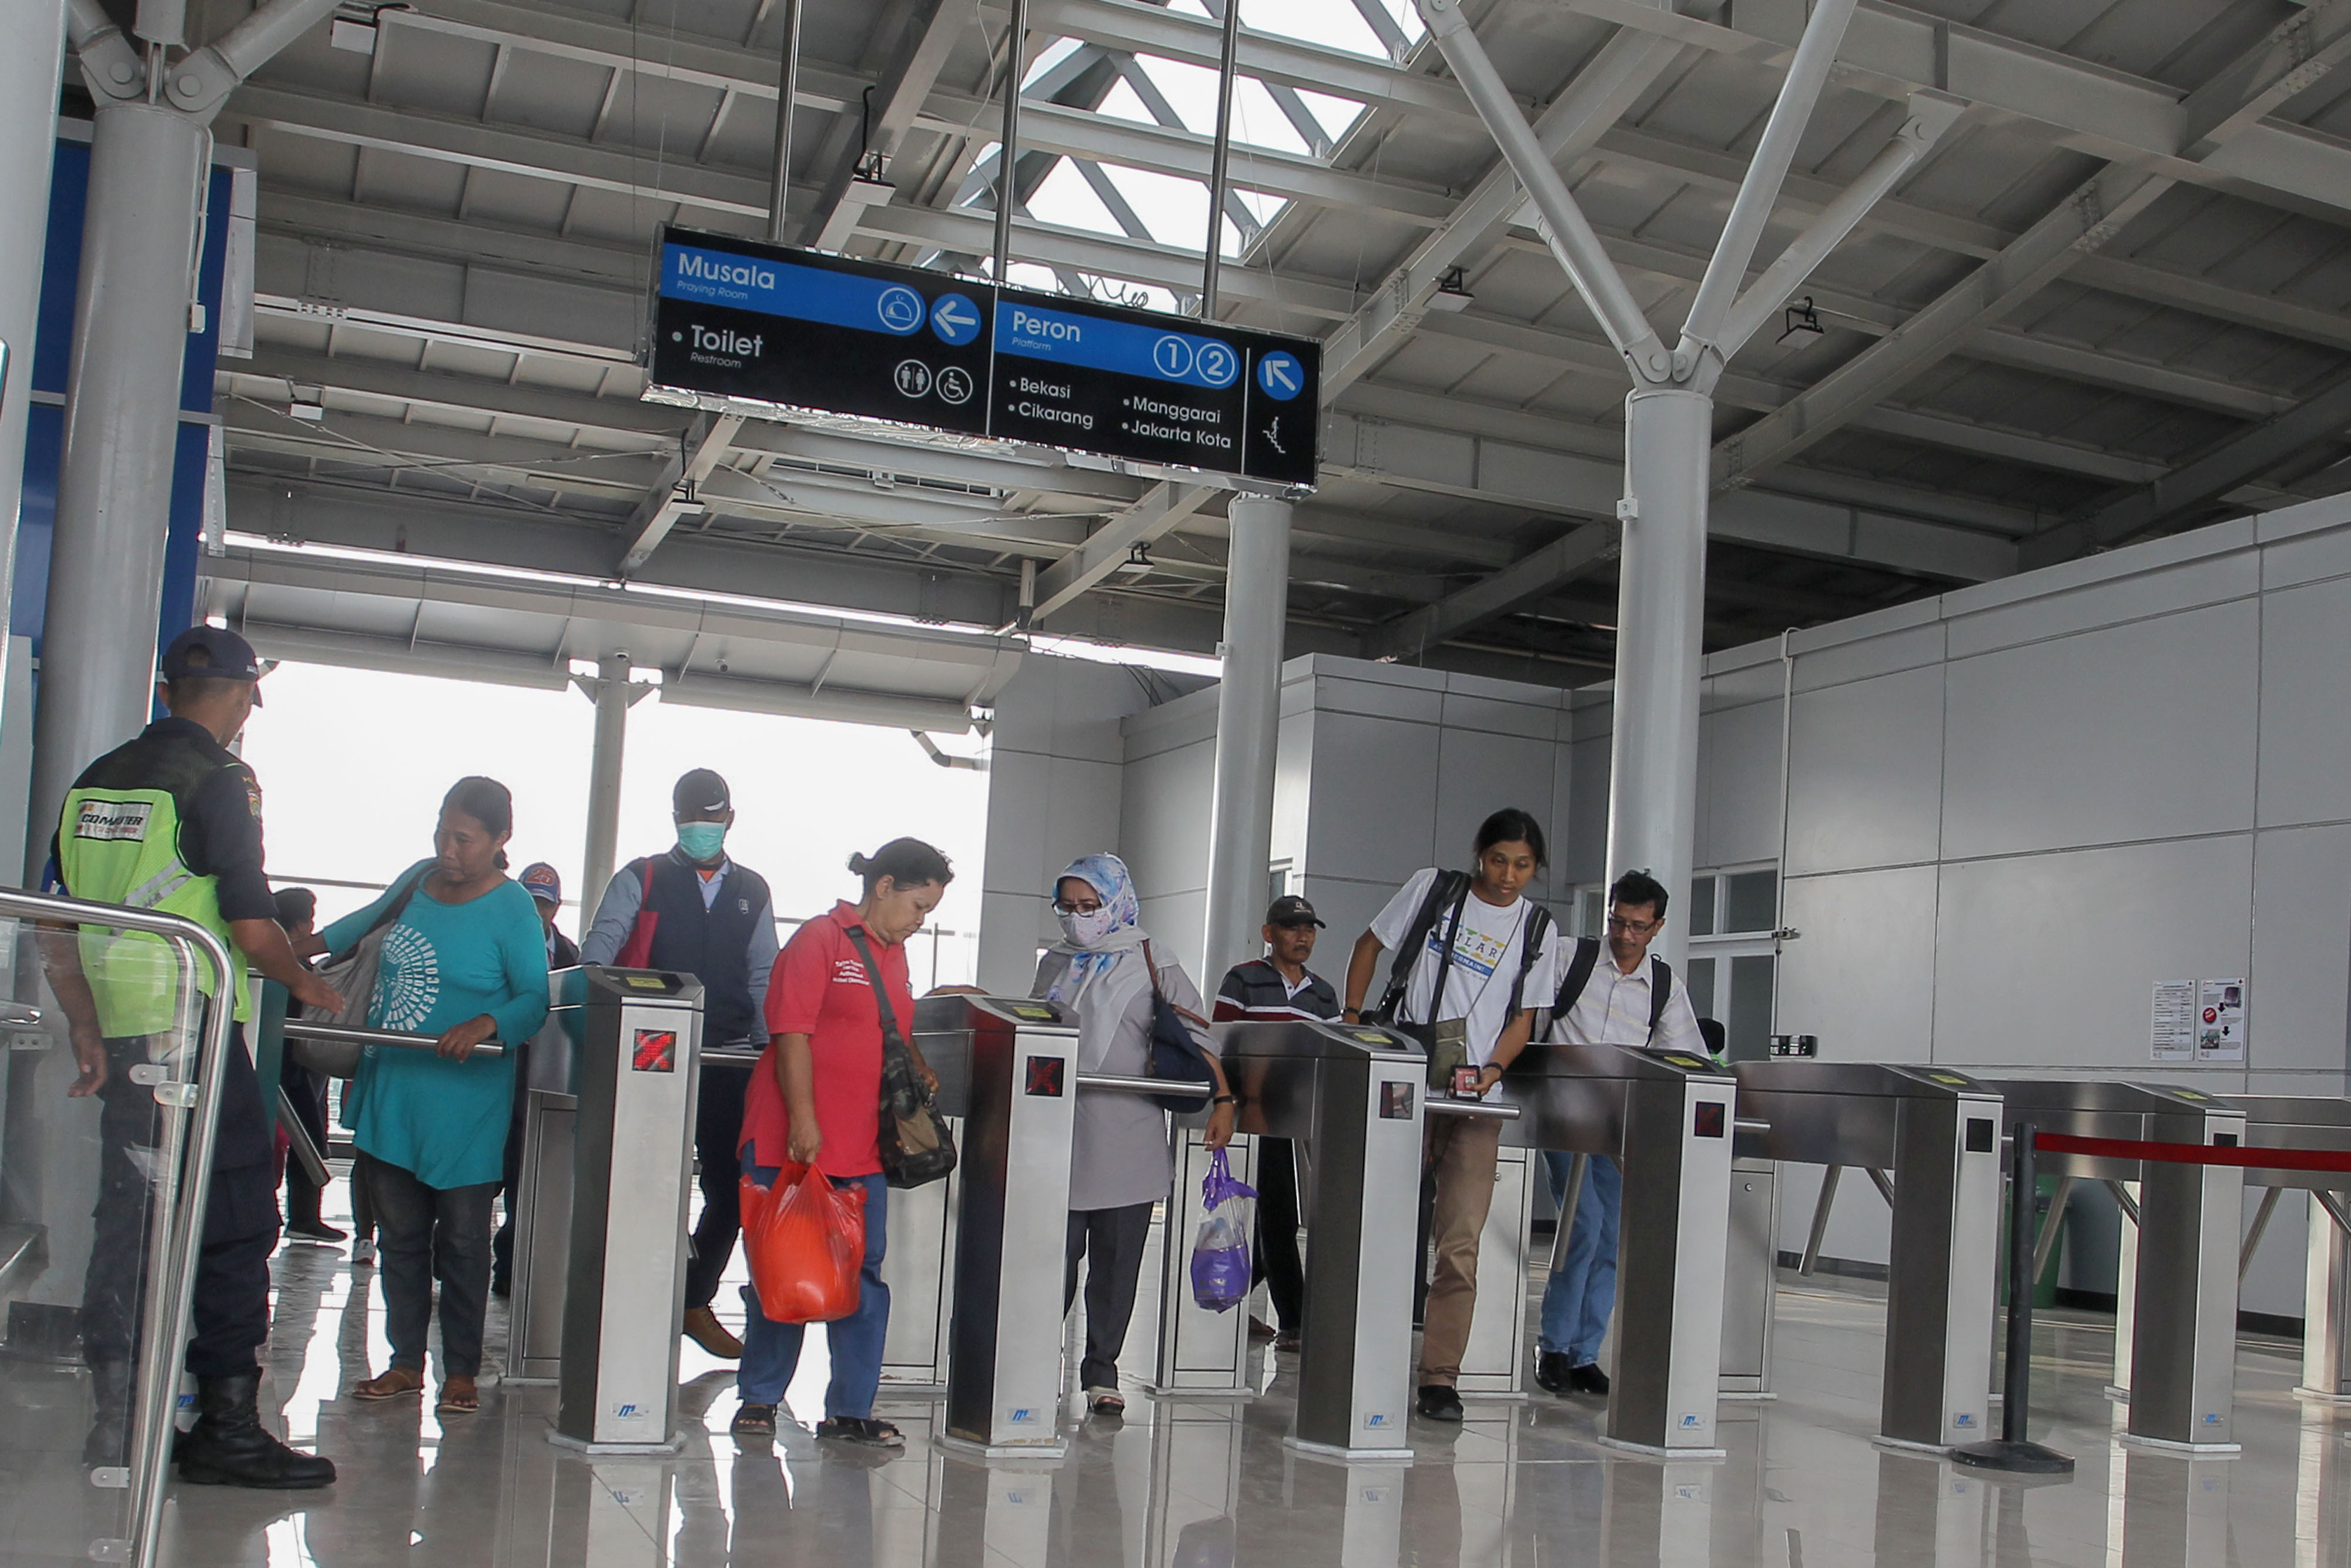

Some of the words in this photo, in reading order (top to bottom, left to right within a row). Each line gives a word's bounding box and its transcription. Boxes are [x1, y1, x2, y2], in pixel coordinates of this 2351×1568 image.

[679, 253, 774, 289] Musala
[677, 280, 715, 296] Praying
[718, 287, 748, 299] Room
[1013, 311, 1080, 341] Peron
[691, 324, 762, 357] Toilet
[1012, 337, 1051, 350] Platform
[691, 352, 741, 367] Restroom
[1167, 343, 1178, 369] 1
[1207, 350, 1225, 377] 2
[1020, 377, 1070, 398] Bekasi
[1019, 402, 1093, 429] Cikarang
[1134, 396, 1220, 423] Manggarai
[1131, 420, 1190, 441] Jakarta
[1197, 431, 1230, 448] Kota
